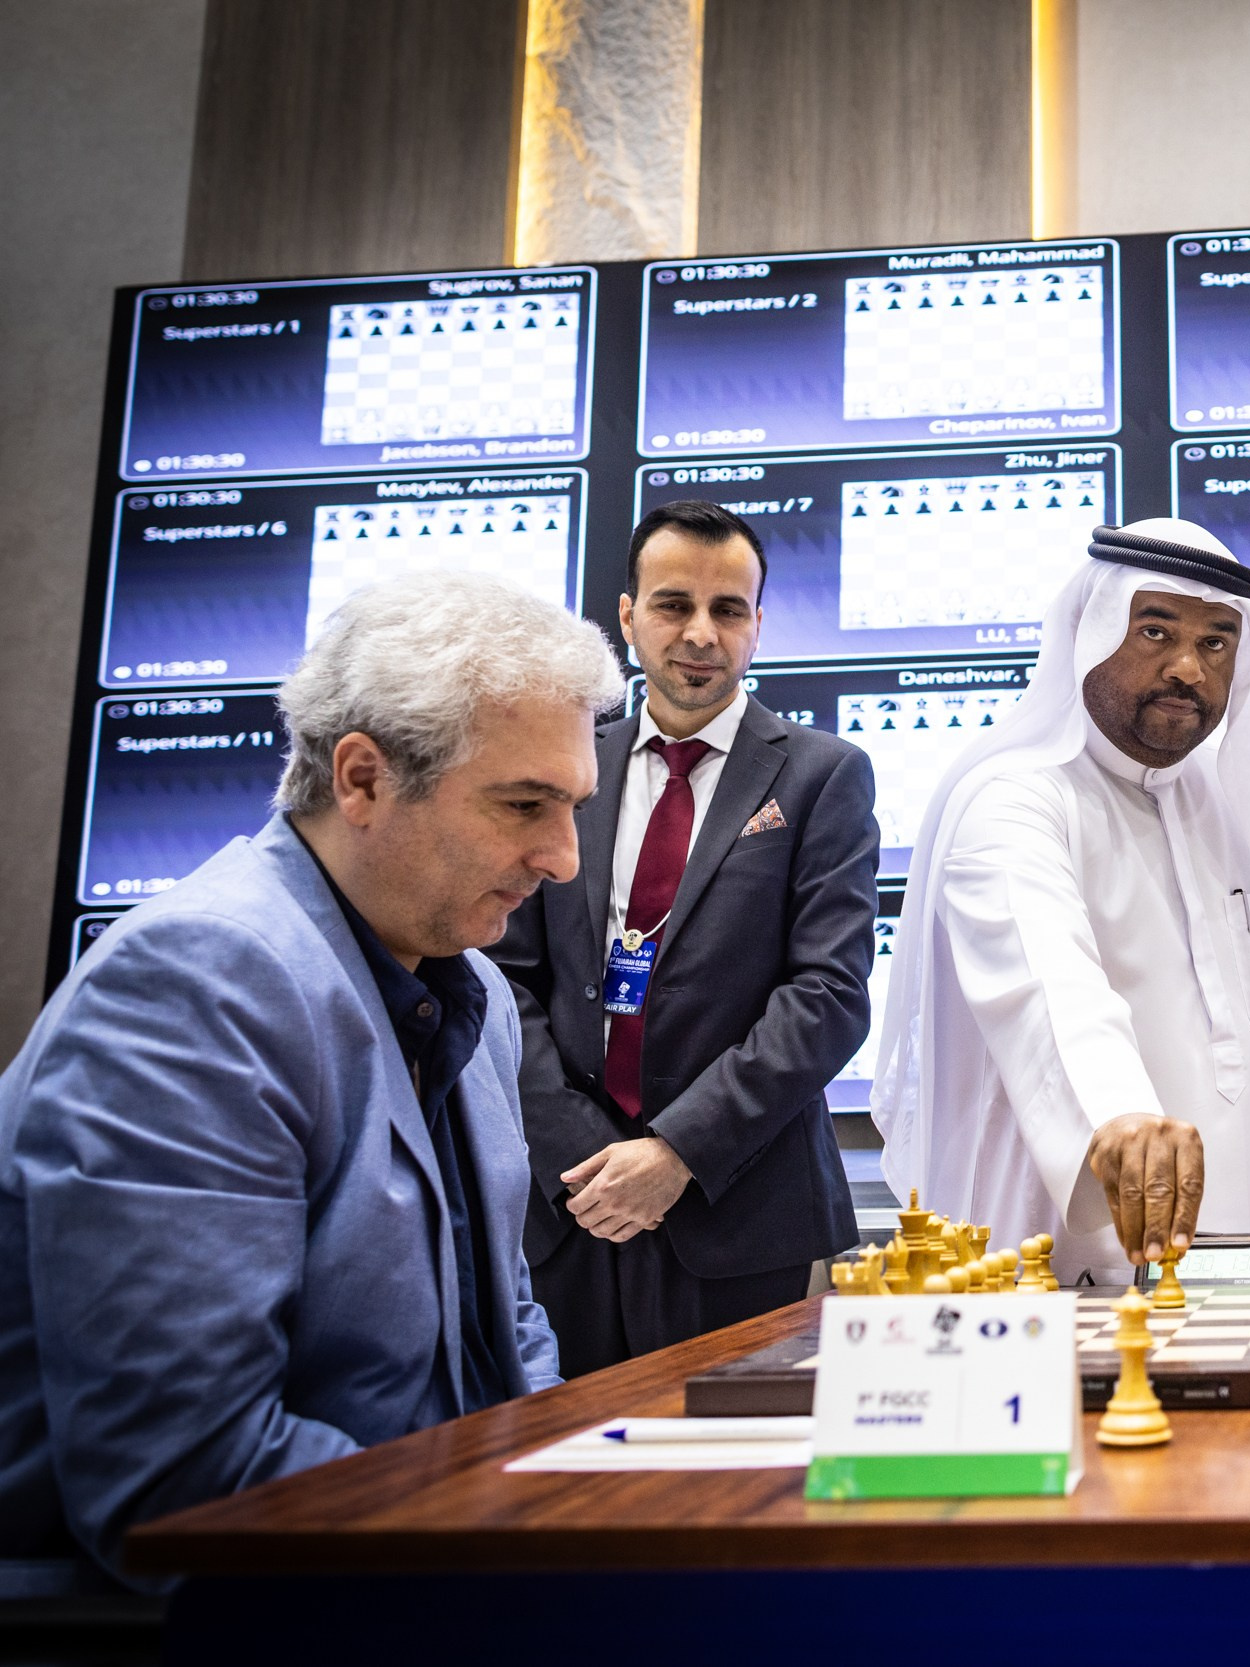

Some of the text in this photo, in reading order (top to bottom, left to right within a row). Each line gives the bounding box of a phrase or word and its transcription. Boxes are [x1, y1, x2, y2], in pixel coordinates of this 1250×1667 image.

[978, 245, 1105, 265] Mahammad
[680, 263, 770, 282] 01:30:30
[429, 275, 583, 297] Sjugirov, Sanan
[172, 290, 258, 308] 01:30:30
[674, 296, 787, 315] Superstars
[802, 293, 817, 307] 2
[163, 321, 272, 341] Superstars
[290, 320, 300, 334] 1
[929, 414, 1106, 434] Cheparinov, Ivan
[675, 428, 765, 447] 01:30:30
[380, 438, 575, 463] Jacobson, Brandon
[1005, 452, 1107, 468] Zhu, Jiner
[156, 451, 245, 470] 01:30:30
[674, 466, 765, 484] 01:30:30
[377, 476, 574, 498] Motylev, Alexander
[153, 489, 242, 508] 01:30:30
[798, 497, 813, 512] 7
[144, 524, 258, 543] Superstars
[272, 521, 286, 536] 6
[976, 626, 1042, 643] LU, Sh
[136, 660, 227, 678] 01:30:30
[899, 668, 1020, 685] Daneshvar,
[133, 698, 224, 716] 01:30:30
[117, 735, 231, 753] Superstars
[250, 731, 274, 746] 11
[618, 1005, 637, 1013] PLAY
[1004, 1394, 1021, 1424] 1
